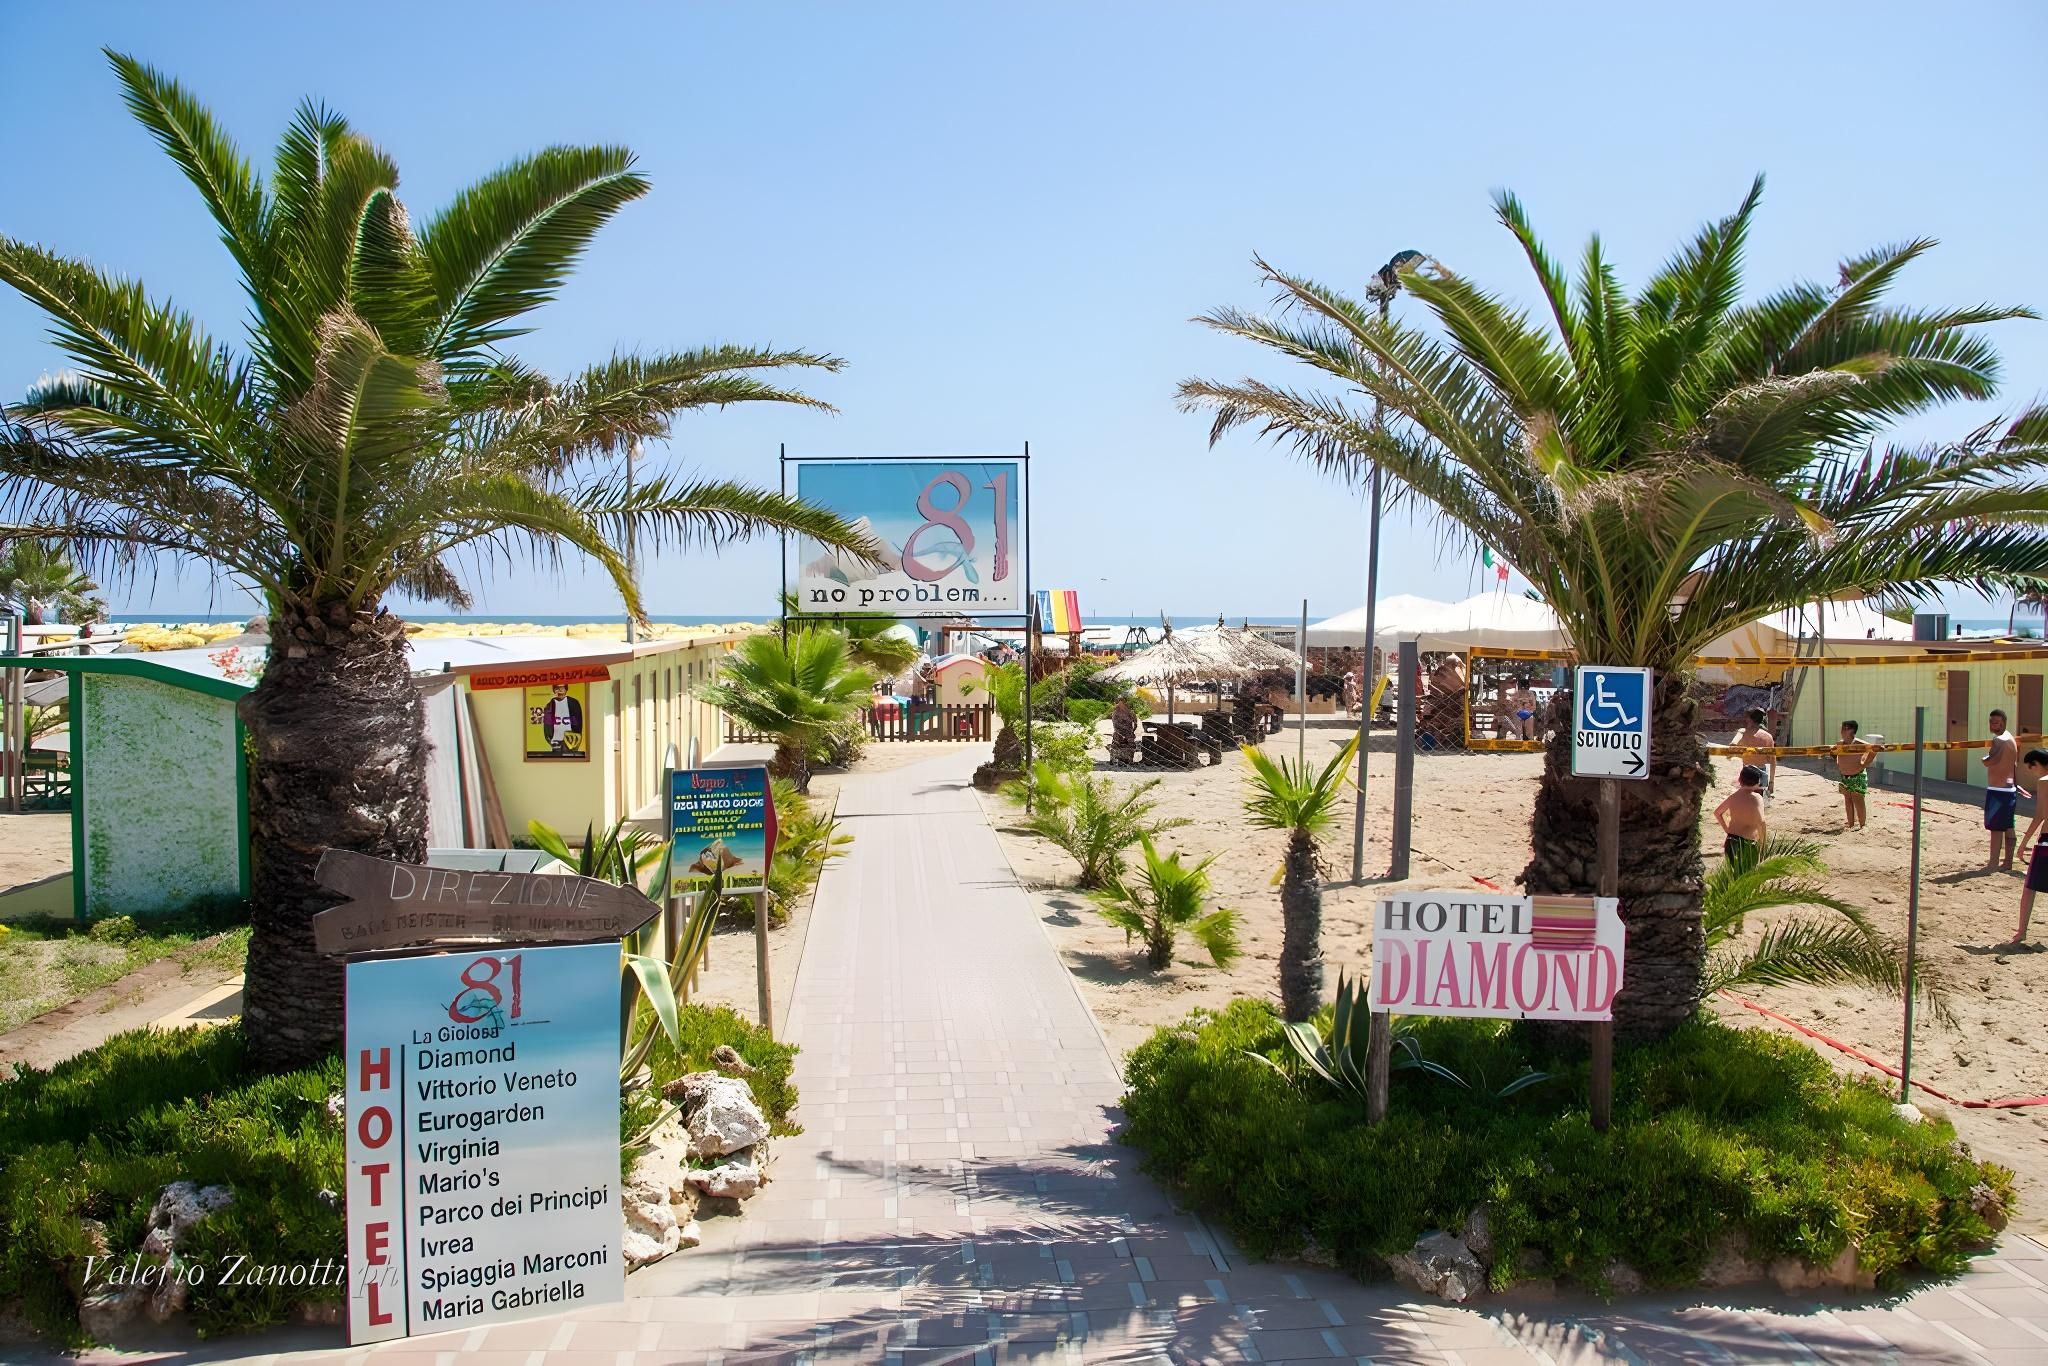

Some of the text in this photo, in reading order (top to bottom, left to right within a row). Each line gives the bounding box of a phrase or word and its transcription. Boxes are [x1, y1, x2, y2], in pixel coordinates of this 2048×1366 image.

[902, 471, 1009, 582] 81
[810, 589, 846, 602] no
[1576, 731, 1642, 750] SCIVOLO
[390, 865, 602, 910] DIREZIONE
[1383, 901, 1532, 934] HOTEL
[448, 954, 522, 1023] 81
[1376, 938, 1617, 1013] DIAMOND
[412, 1029, 432, 1045] La
[418, 1041, 515, 1070] Diamond
[417, 1069, 577, 1101] Vittorio Veneto
[418, 1103, 544, 1132] Eurogarden
[418, 1137, 500, 1164] Virginia
[358, 1047, 393, 1327] HOTEL
[419, 1167, 500, 1195] Mario's
[419, 1185, 609, 1227] Parco dei Principi
[420, 1235, 474, 1258] Ivrea
[421, 1245, 608, 1292] Spiaggia Marconi
[422, 1281, 585, 1322] Maria Gabriella
